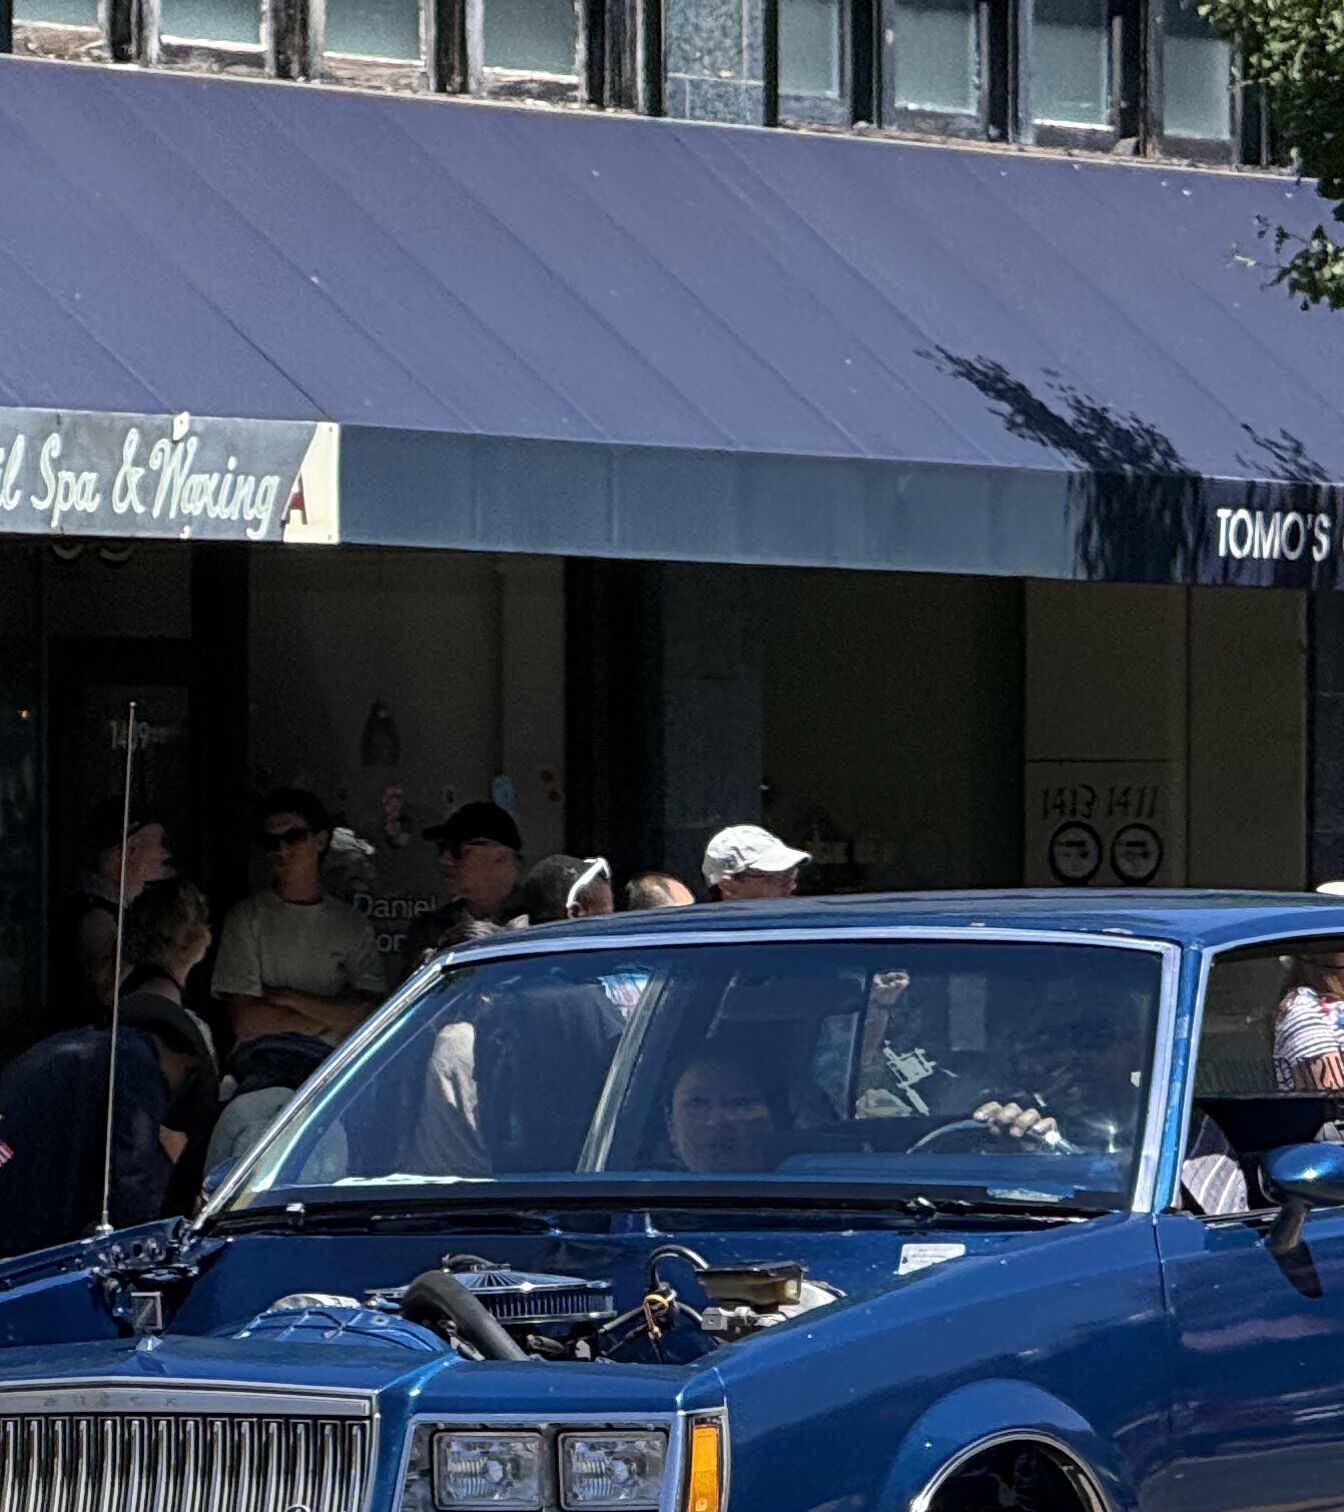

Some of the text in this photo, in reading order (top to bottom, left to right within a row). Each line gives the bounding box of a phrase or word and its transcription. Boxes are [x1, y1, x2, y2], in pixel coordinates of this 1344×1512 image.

[30, 432, 103, 528] Spa
[112, 427, 148, 514] &
[149, 434, 280, 539] Waxing
[1216, 508, 1331, 562] TOMO'S
[1042, 784, 1160, 820] 1413 1411
